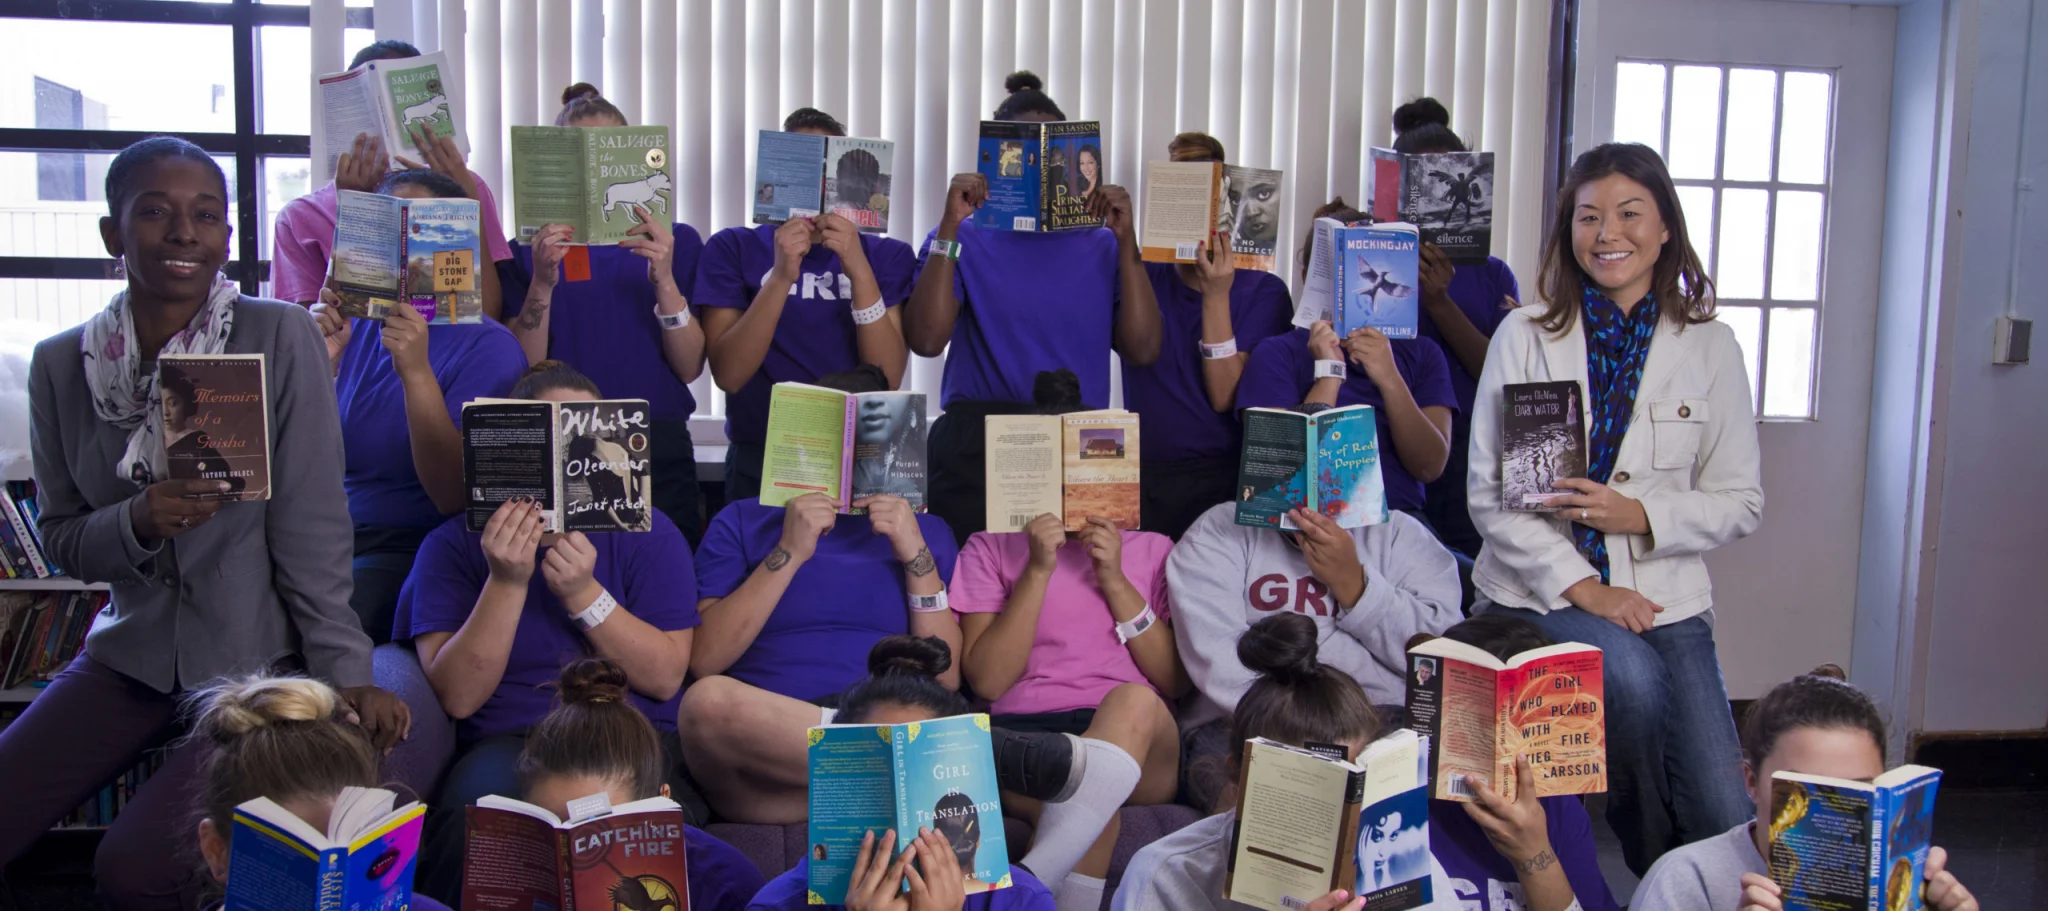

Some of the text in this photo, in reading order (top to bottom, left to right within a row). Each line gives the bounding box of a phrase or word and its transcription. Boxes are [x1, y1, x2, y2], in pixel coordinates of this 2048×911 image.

[391, 70, 438, 85] SALVAGE
[395, 91, 430, 104] BONES
[1066, 123, 1099, 132] SASSON
[599, 134, 665, 148] SALVAGE
[599, 152, 615, 162] the
[600, 164, 648, 178] BONES
[1409, 185, 1421, 222] silence
[604, 231, 626, 239] JESM
[1436, 232, 1474, 244] silence
[1231, 246, 1273, 255] RESPECT
[1347, 240, 1415, 251] MOCKINGJAY
[445, 257, 460, 265] BIG
[439, 267, 467, 275] STONE
[444, 278, 462, 286] GAP
[1382, 327, 1412, 336] COLLINS
[193, 388, 260, 403] Memoirs
[1514, 391, 1532, 401] Laura
[1515, 403, 1560, 417] DARK WATER
[193, 411, 223, 428] of a
[560, 406, 649, 437] White
[196, 434, 246, 449] Geisha
[1319, 441, 1374, 459] Sky of Red
[566, 457, 649, 476] Oleander
[895, 461, 920, 469] Purple
[1335, 457, 1376, 470] Poppies
[567, 496, 647, 515] Janet Fitch
[1249, 573, 1338, 617] GR
[1528, 665, 1548, 680] THE
[1555, 676, 1583, 689] GIRL
[1520, 695, 1542, 711] WHO
[1551, 701, 1597, 717] PLAYED
[1522, 723, 1550, 739] WITH
[1561, 732, 1590, 746] FIRE
[1543, 763, 1599, 778] LARSSON
[896, 731, 908, 826] GIRL IN TRANSLATION
[947, 786, 960, 796] IN
[575, 822, 680, 854] CATCHING
[624, 841, 674, 858] FIRE
[1868, 820, 1882, 898] JOHN GRISHAM THE
[964, 870, 991, 880] KWOK
[330, 871, 343, 911] SISTE
[564, 878, 573, 911] CATCH
[1385, 885, 1408, 896] LARSEN
